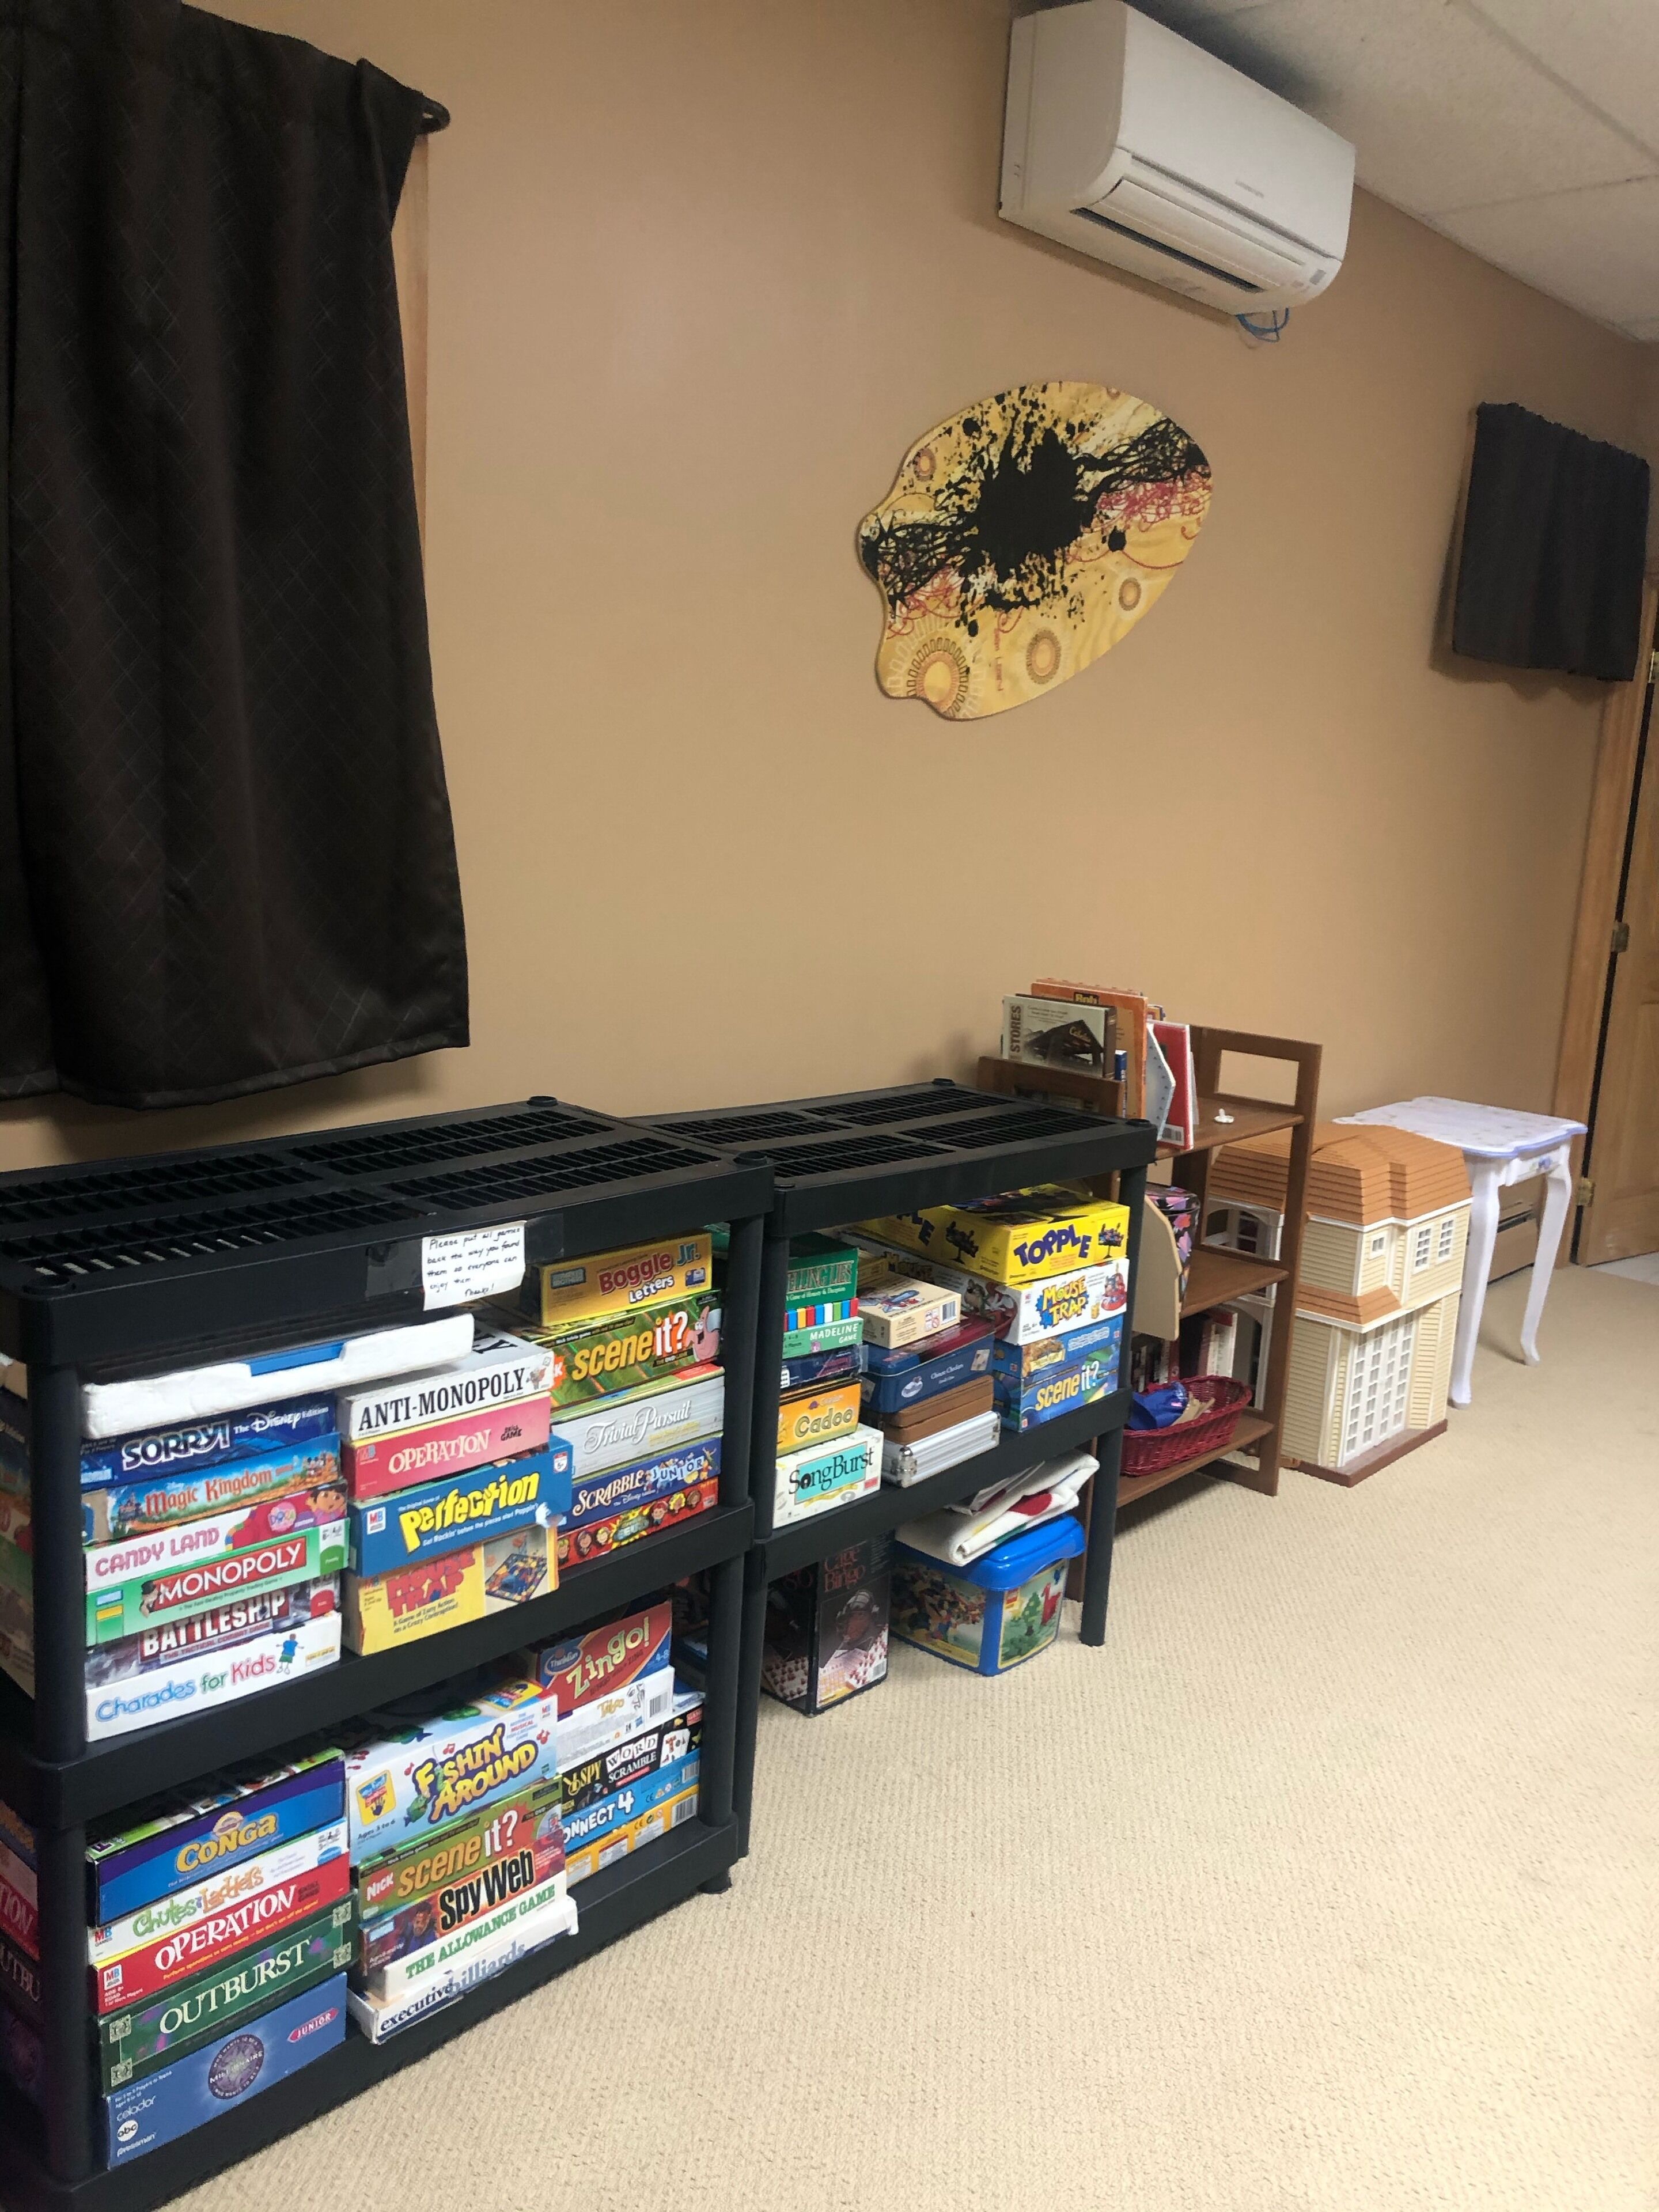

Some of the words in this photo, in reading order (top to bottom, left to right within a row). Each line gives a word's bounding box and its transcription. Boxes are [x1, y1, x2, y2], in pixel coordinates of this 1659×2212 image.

[1010, 1005, 1021, 1052] STORES
[429, 1239, 458, 1250] Please
[463, 1234, 476, 1247] put
[494, 1228, 520, 1241] games
[468, 1248, 484, 1257] way
[486, 1246, 499, 1256] you
[501, 1240, 520, 1251] found
[1014, 1224, 1092, 1267] TOPPLE
[468, 1259, 499, 1270] everyone
[599, 1253, 673, 1296] Boggle
[677, 1242, 701, 1266] Jr.
[430, 1282, 448, 1293] enjoy
[629, 1275, 674, 1304] Letters
[1043, 1275, 1086, 1310] MOUSE
[810, 1323, 859, 1340] MADELINE
[1050, 1297, 1086, 1326] TRAP
[572, 1330, 653, 1381] scene
[655, 1311, 688, 1357] it?
[839, 1333, 857, 1343] GAME
[358, 1367, 526, 1432] ANTI-MONOPOLY
[1035, 1373, 1081, 1411] scene
[1081, 1361, 1100, 1391] it?
[233, 1423, 249, 1434] The
[302, 1406, 329, 1419] Edition
[501, 1429, 522, 1441] GAME
[583, 1416, 642, 1454] Trivial
[632, 1400, 692, 1445] Pursuit
[794, 1408, 854, 1438] Cadoo
[121, 1420, 232, 1471] SORRY!
[388, 1429, 492, 1475] OPERATION
[145, 1486, 198, 1518] Magic
[205, 1468, 272, 1501] Kingdom
[573, 1469, 649, 1517] SCRABBLE
[651, 1456, 704, 1482] JUNIOR
[399, 1472, 540, 1554] Perfection
[95, 1540, 165, 1577] CANDY
[170, 1525, 220, 1556] LAND
[158, 1542, 302, 1606] MONOPOLY
[825, 1565, 866, 1593] Bingo
[143, 1590, 286, 1658] BATTLESHIP
[399, 1615, 415, 1624] Game
[566, 1616, 650, 1699] Zingo!
[96, 1679, 196, 1722] Charades
[200, 1672, 228, 1694] for
[230, 1654, 276, 1685] Kids
[580, 1760, 601, 1787] SPY
[608, 1737, 656, 1767] WORD
[608, 1752, 656, 1783] SCRAMBLE
[429, 1741, 537, 1822] AROUND
[617, 1790, 635, 1815] 4
[358, 1829, 374, 1839] Ages
[397, 1835, 482, 1897] scene
[484, 1810, 518, 1857] it?
[132, 1898, 196, 1937] Chutes
[199, 1865, 264, 1914] Ladders
[95, 1926, 112, 1942] MB
[154, 1884, 297, 1970] OPERATION
[406, 1953, 435, 1979] THE
[438, 1907, 517, 1963] ALLOWANCE
[518, 1884, 555, 1916] GAME
[106, 1968, 120, 1982] MB
[160, 1941, 310, 2035] OUTBURST
[448, 1939, 525, 1997] billiards
[296, 2012, 332, 2039] JUNIOR
[118, 2123, 137, 2138] abc
